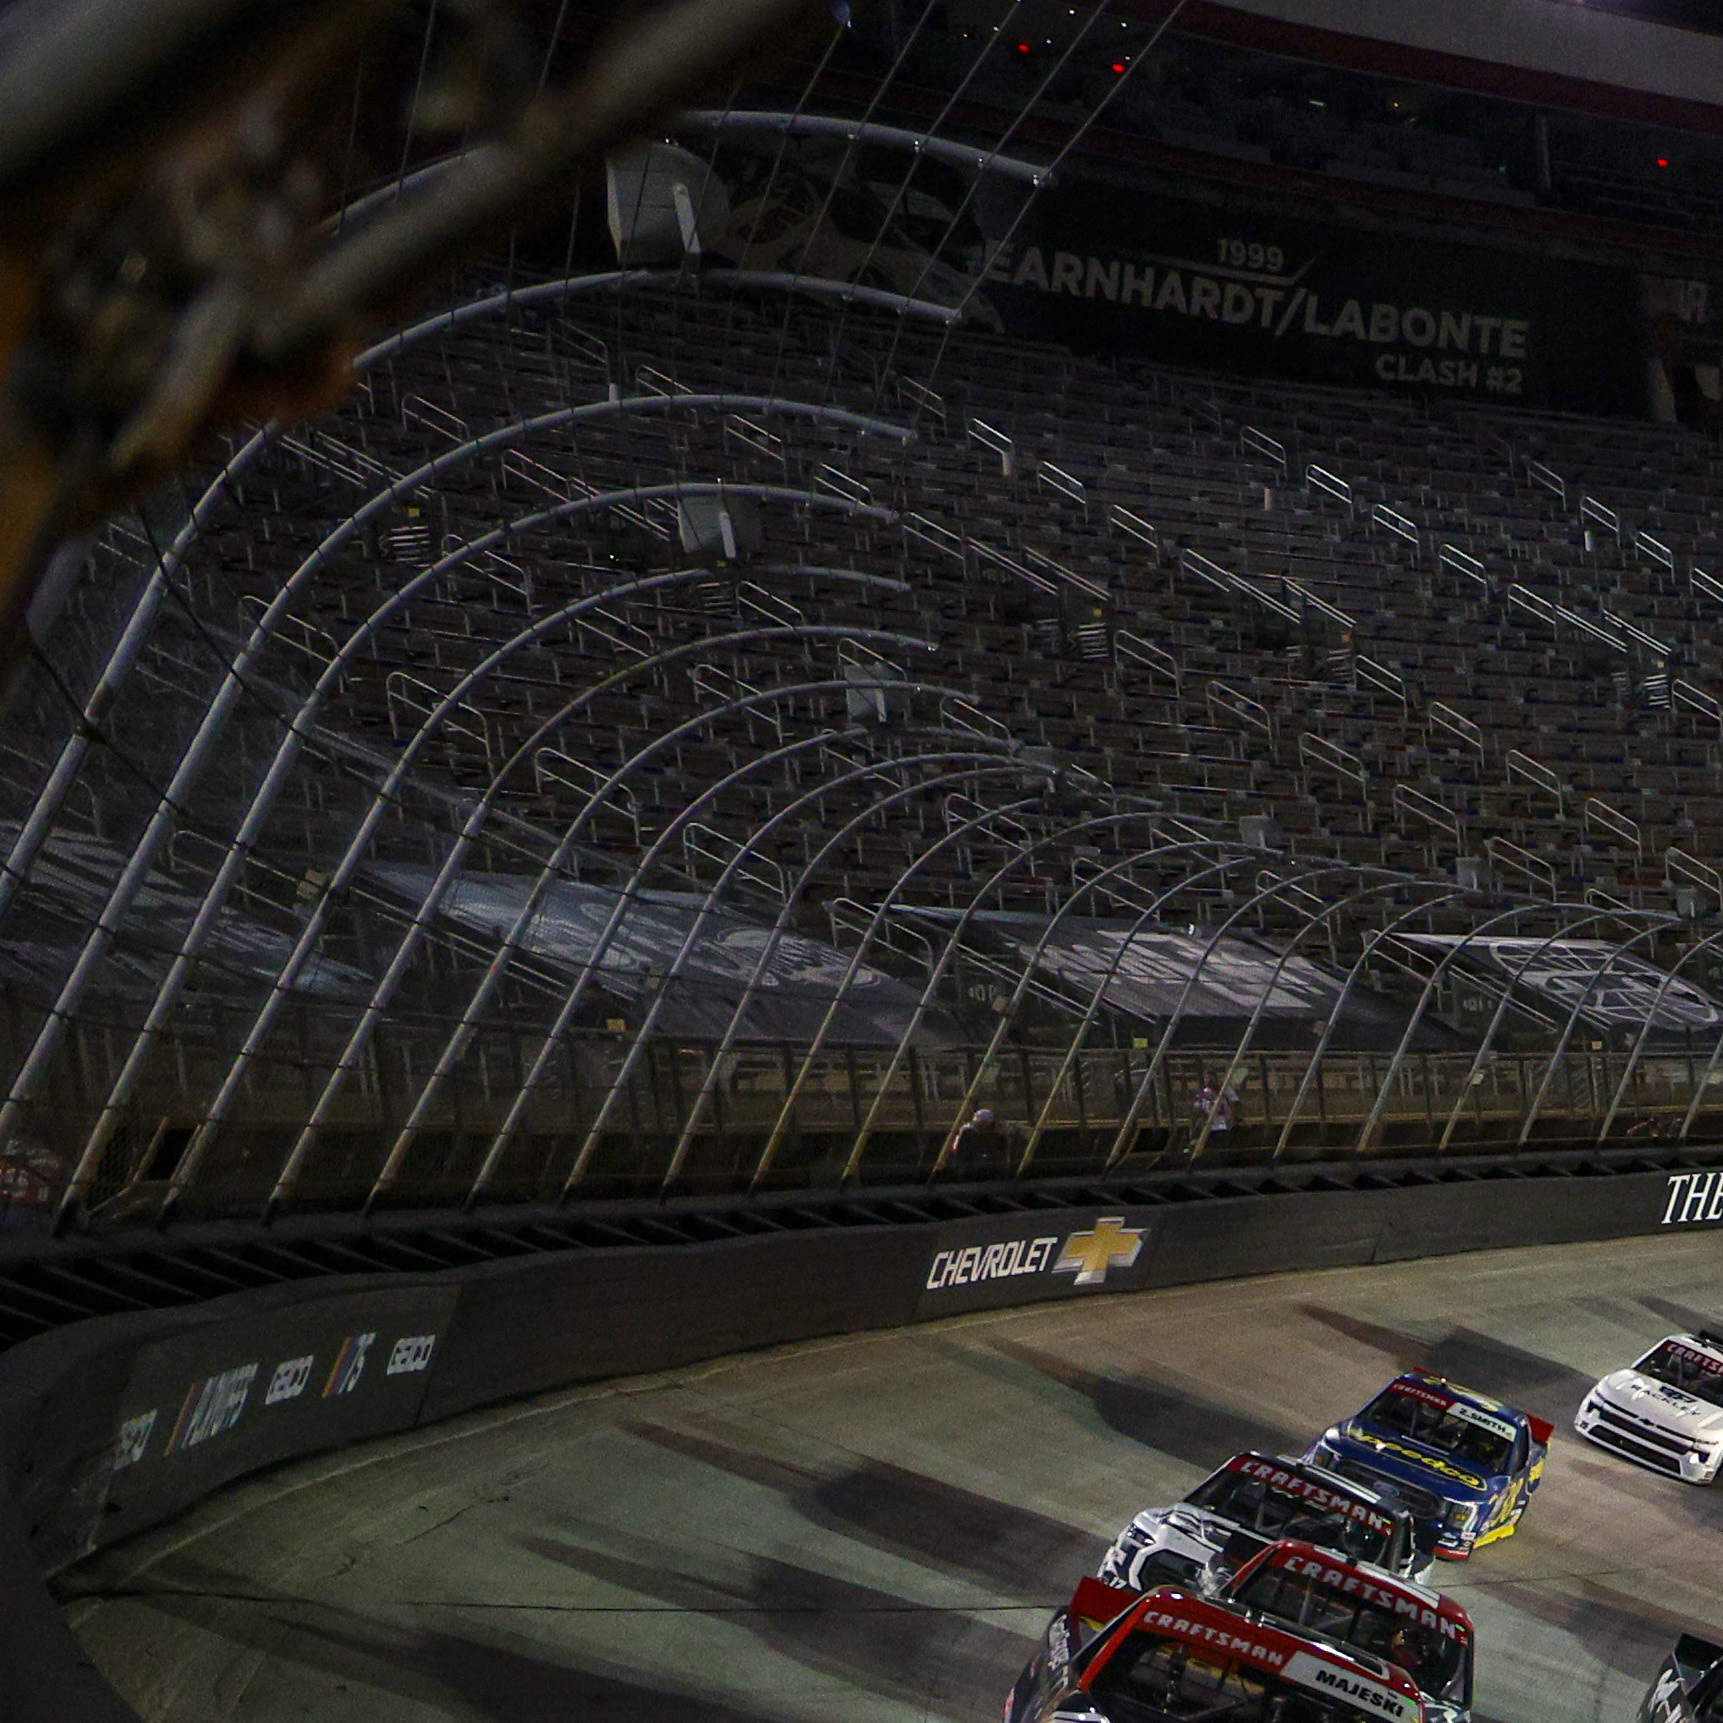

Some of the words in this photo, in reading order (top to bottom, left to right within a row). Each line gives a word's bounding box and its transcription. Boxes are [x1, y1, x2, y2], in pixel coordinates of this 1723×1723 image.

[1217, 236, 1284, 272] 1999
[1375, 352, 1477, 390] CLASH
[1485, 364, 1524, 396] #2
[926, 1235, 1057, 1292] CHEVROLET
[1629, 1382, 1702, 1417] RACKLEY
[1239, 1458, 1386, 1532] CRAFTSMAN
[1284, 1555, 1458, 1642] CRAFTSMAN
[1144, 1610, 1286, 1668] CRAFTSMAN
[1314, 1668, 1405, 1718] MAJESKI
